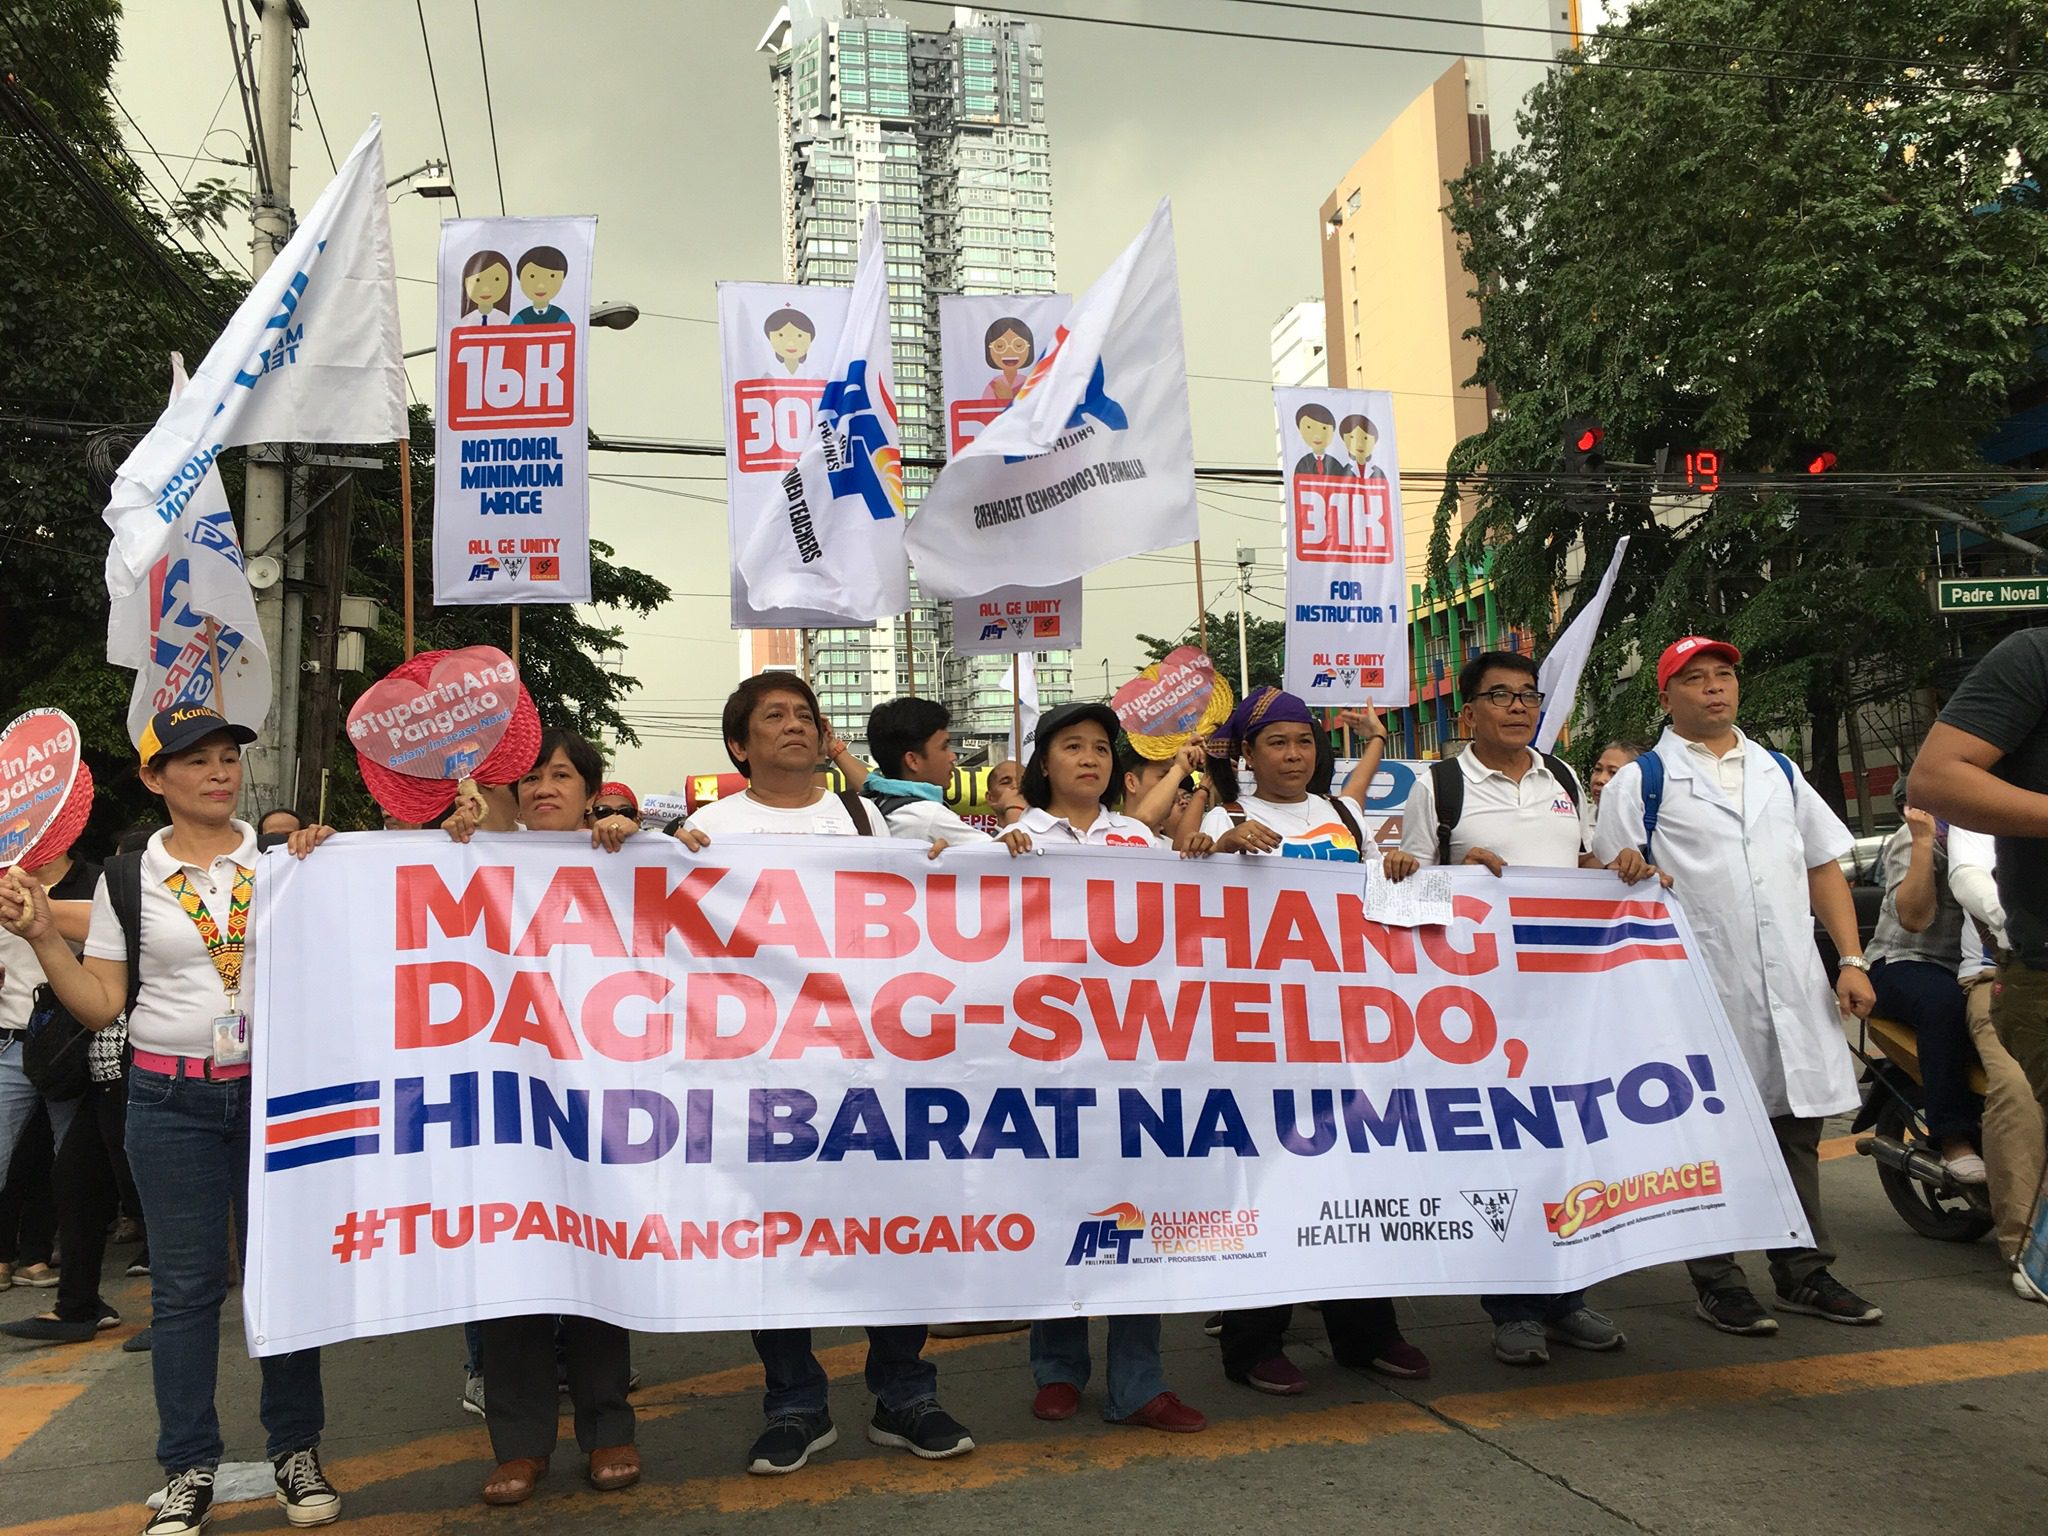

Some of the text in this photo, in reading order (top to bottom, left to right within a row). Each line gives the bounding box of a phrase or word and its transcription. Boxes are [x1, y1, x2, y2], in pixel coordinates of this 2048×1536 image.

[457, 343, 566, 410] 16K
[743, 397, 819, 454] 30
[461, 437, 563, 463] NATIONAL
[461, 463, 563, 490] MINIMUM
[1686, 452, 1719, 491] 19
[480, 491, 543, 515] WAGE
[789, 499, 822, 564] TEACHERS
[1300, 490, 1387, 548] 31K
[468, 538, 560, 554] ALL GE UNITY
[1330, 580, 1362, 600] FOR
[1951, 588, 1994, 603] Padre
[2000, 586, 2040, 601] Noval
[980, 600, 1061, 617] ALL GE UNITY
[1296, 605, 1397, 624] INSTRUCTOR 1
[1313, 653, 1385, 666] ALL GE UNITY
[350, 659, 516, 741] #TuparinAng
[1137, 673, 1204, 722] Pangako
[386, 690, 498, 749] Pangako
[389, 745, 427, 768] Salary
[429, 723, 478, 751] Increase
[395, 864, 1500, 977] MAKABULUHANG
[395, 961, 1529, 1079] DAGDAG-SWELDO,
[394, 1054, 1726, 1165] HINDI BARAT NA UMENTO!
[1150, 1209, 1260, 1226] ALLIANCE OF
[1320, 1197, 1442, 1221] ALLIANCE OF
[1065, 1219, 1145, 1266] ACT
[1151, 1223, 1258, 1240] CONCERNED
[1297, 1220, 1474, 1248] HEALTH WORKERS
[1132, 1251, 1267, 1264] MILITANT PROGRESSIVE NATIONALIST
[1152, 1237, 1245, 1254] TEACHERS
